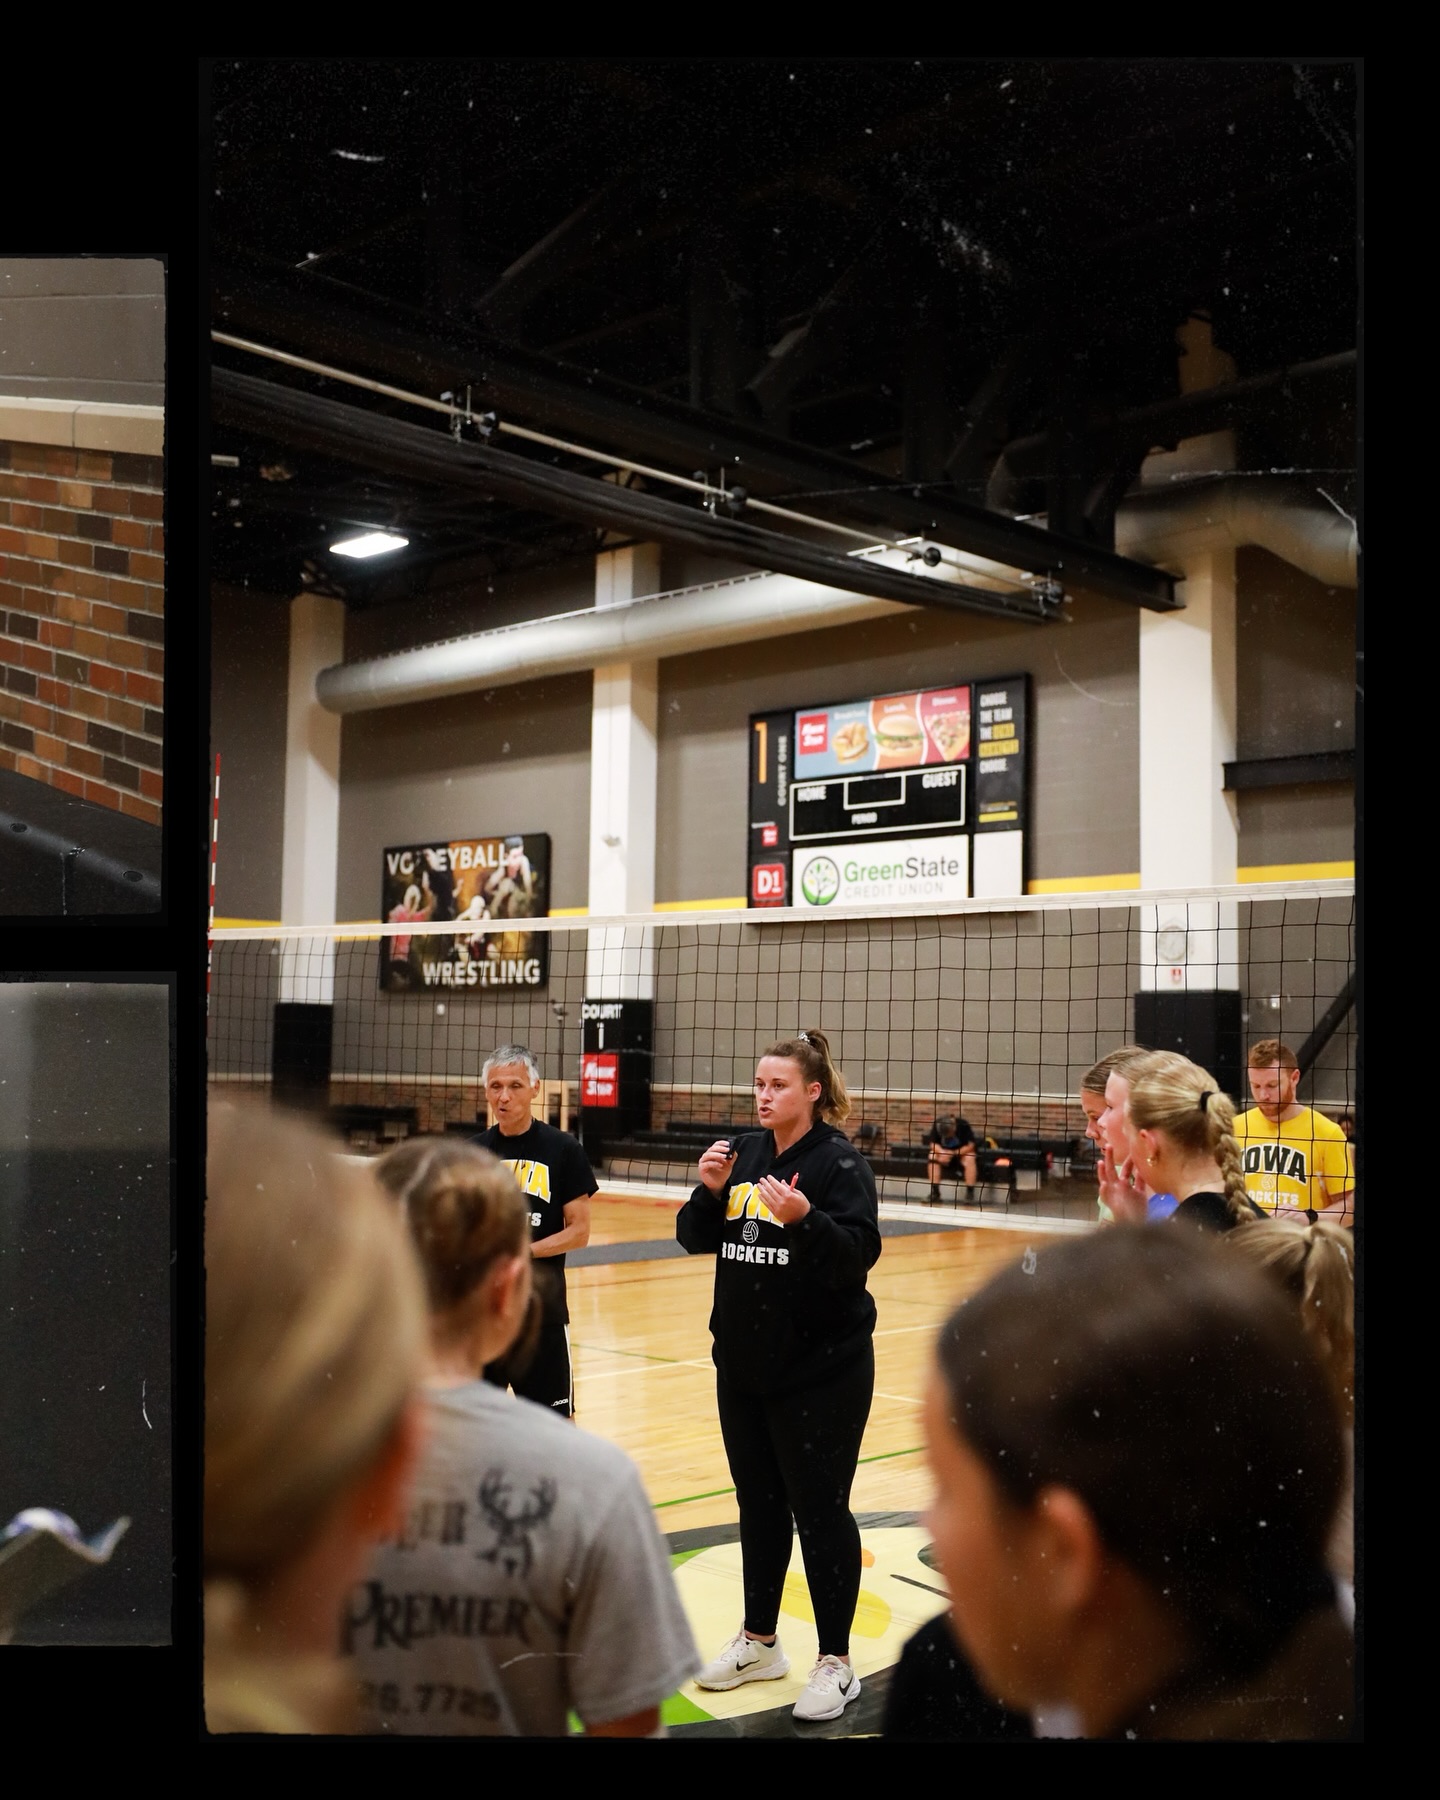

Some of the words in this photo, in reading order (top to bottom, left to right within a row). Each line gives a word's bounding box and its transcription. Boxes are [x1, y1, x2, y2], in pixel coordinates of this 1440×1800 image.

[755, 722, 767, 784] 1
[922, 771, 958, 789] GUEST
[798, 785, 827, 802] HOME
[851, 812, 878, 825] PERIOD
[844, 856, 959, 882] GreenState
[757, 869, 782, 895] D1
[845, 883, 894, 898] CREDIT
[899, 881, 943, 895] UNION
[423, 959, 541, 986] WRESTLING
[582, 1004, 623, 1020] COURT
[1247, 1190, 1299, 1206] OCKETS
[339, 1579, 534, 1658] PREMIER
